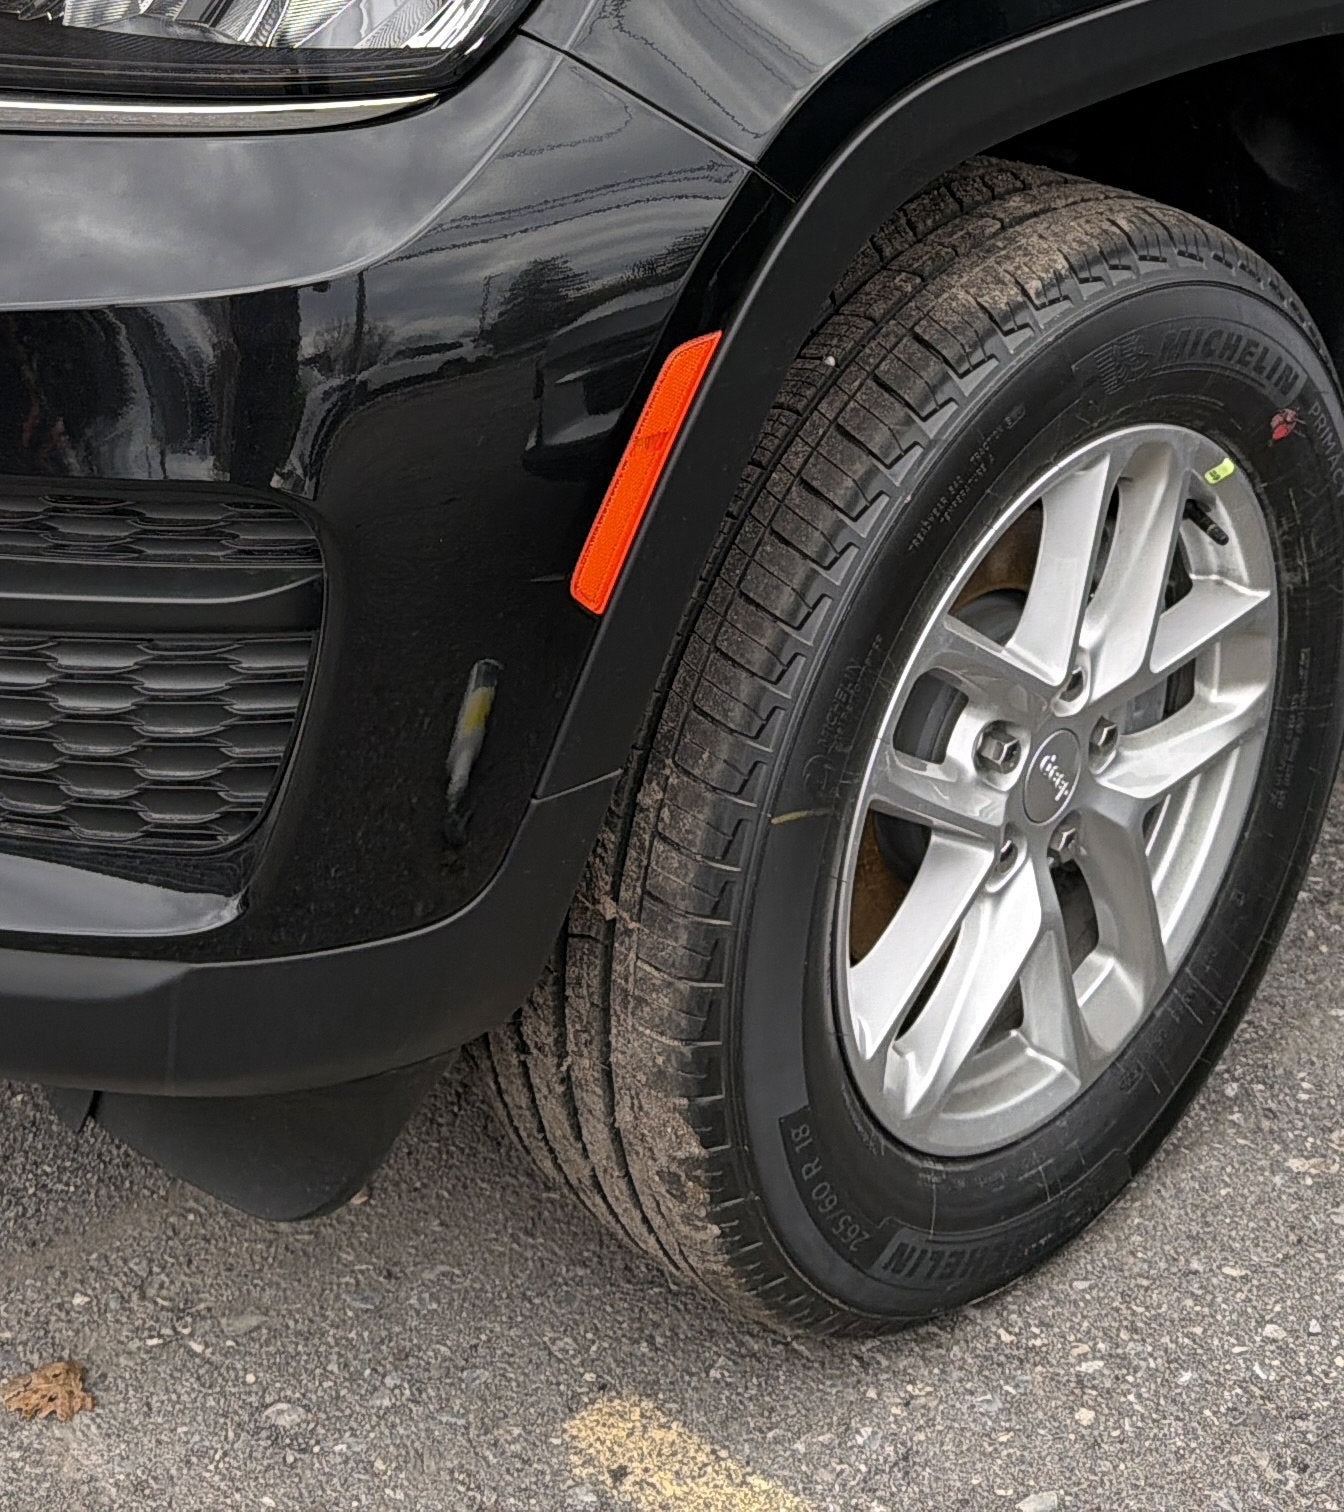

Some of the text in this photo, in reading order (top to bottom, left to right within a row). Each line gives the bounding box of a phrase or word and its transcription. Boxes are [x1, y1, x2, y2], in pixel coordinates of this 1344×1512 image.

[1159, 326, 1301, 397] MICHELIN
[1039, 754, 1070, 802] Jeep
[790, 1122, 870, 1251] 265/60 R 18
